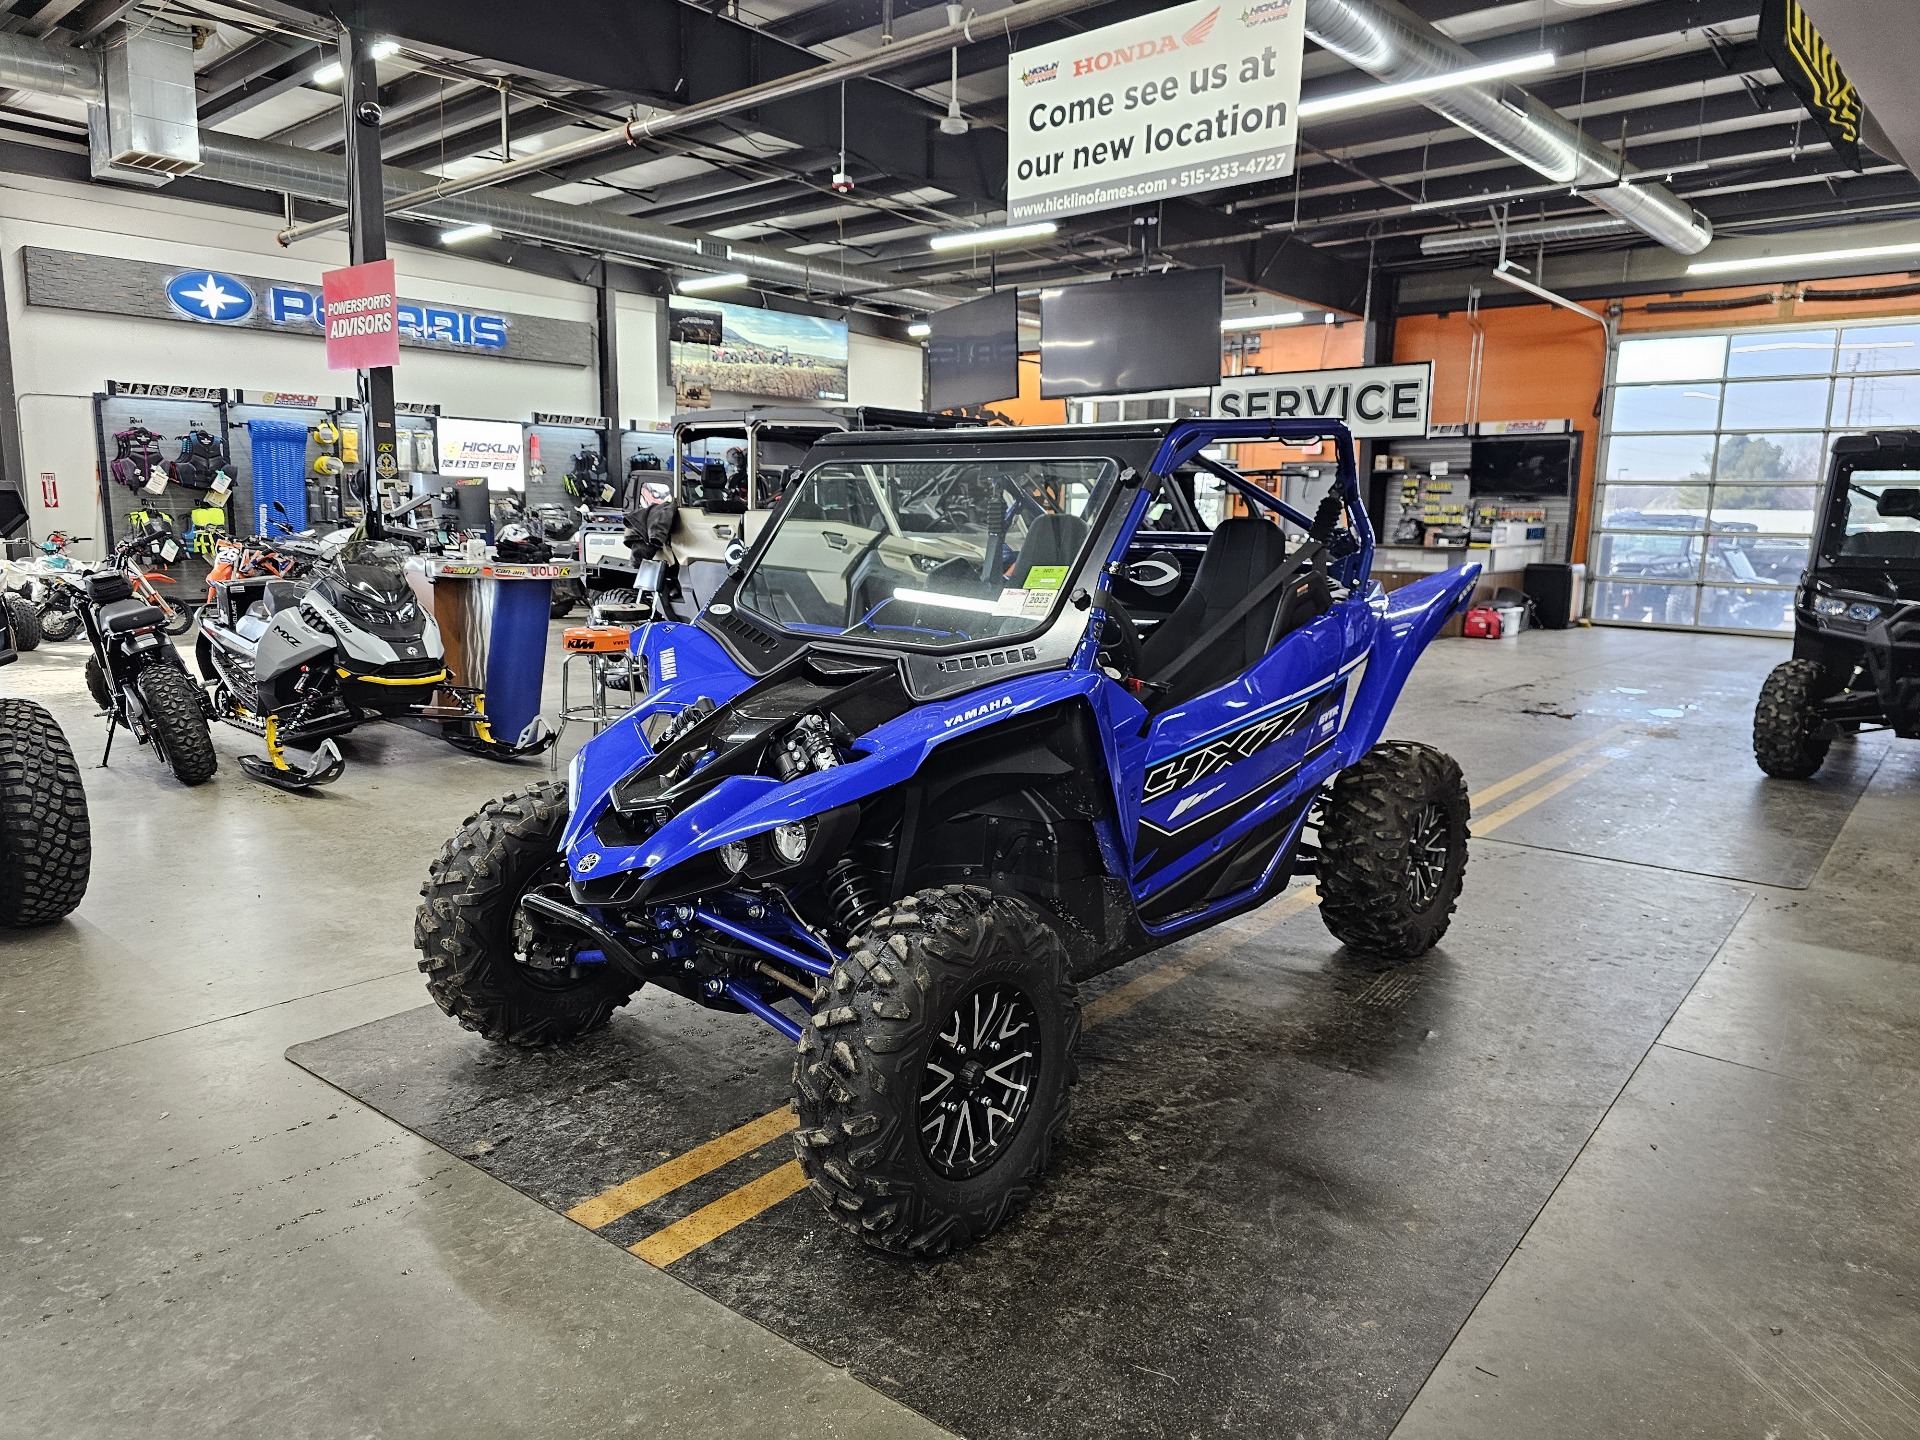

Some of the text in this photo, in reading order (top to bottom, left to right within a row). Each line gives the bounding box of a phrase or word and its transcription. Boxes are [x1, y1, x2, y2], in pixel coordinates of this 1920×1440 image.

[1073, 35, 1180, 78] HONDA
[1029, 46, 1277, 132] Come see us at
[1017, 101, 1288, 180] our new location
[1013, 153, 1287, 218] www.hicklinofames.com 515-233-4727
[327, 293, 392, 317] POWERSPORTS
[330, 312, 393, 340] ADVISORS
[1219, 380, 1421, 423] SERVICE
[461, 441, 521, 454] HICKLIN
[1028, 596, 1050, 604] 2023
[272, 625, 302, 648] MXZ
[324, 608, 353, 635] ski-doo
[567, 638, 595, 649] KTM
[659, 646, 678, 682] YAMAHA
[943, 695, 1013, 728] YAMAHA
